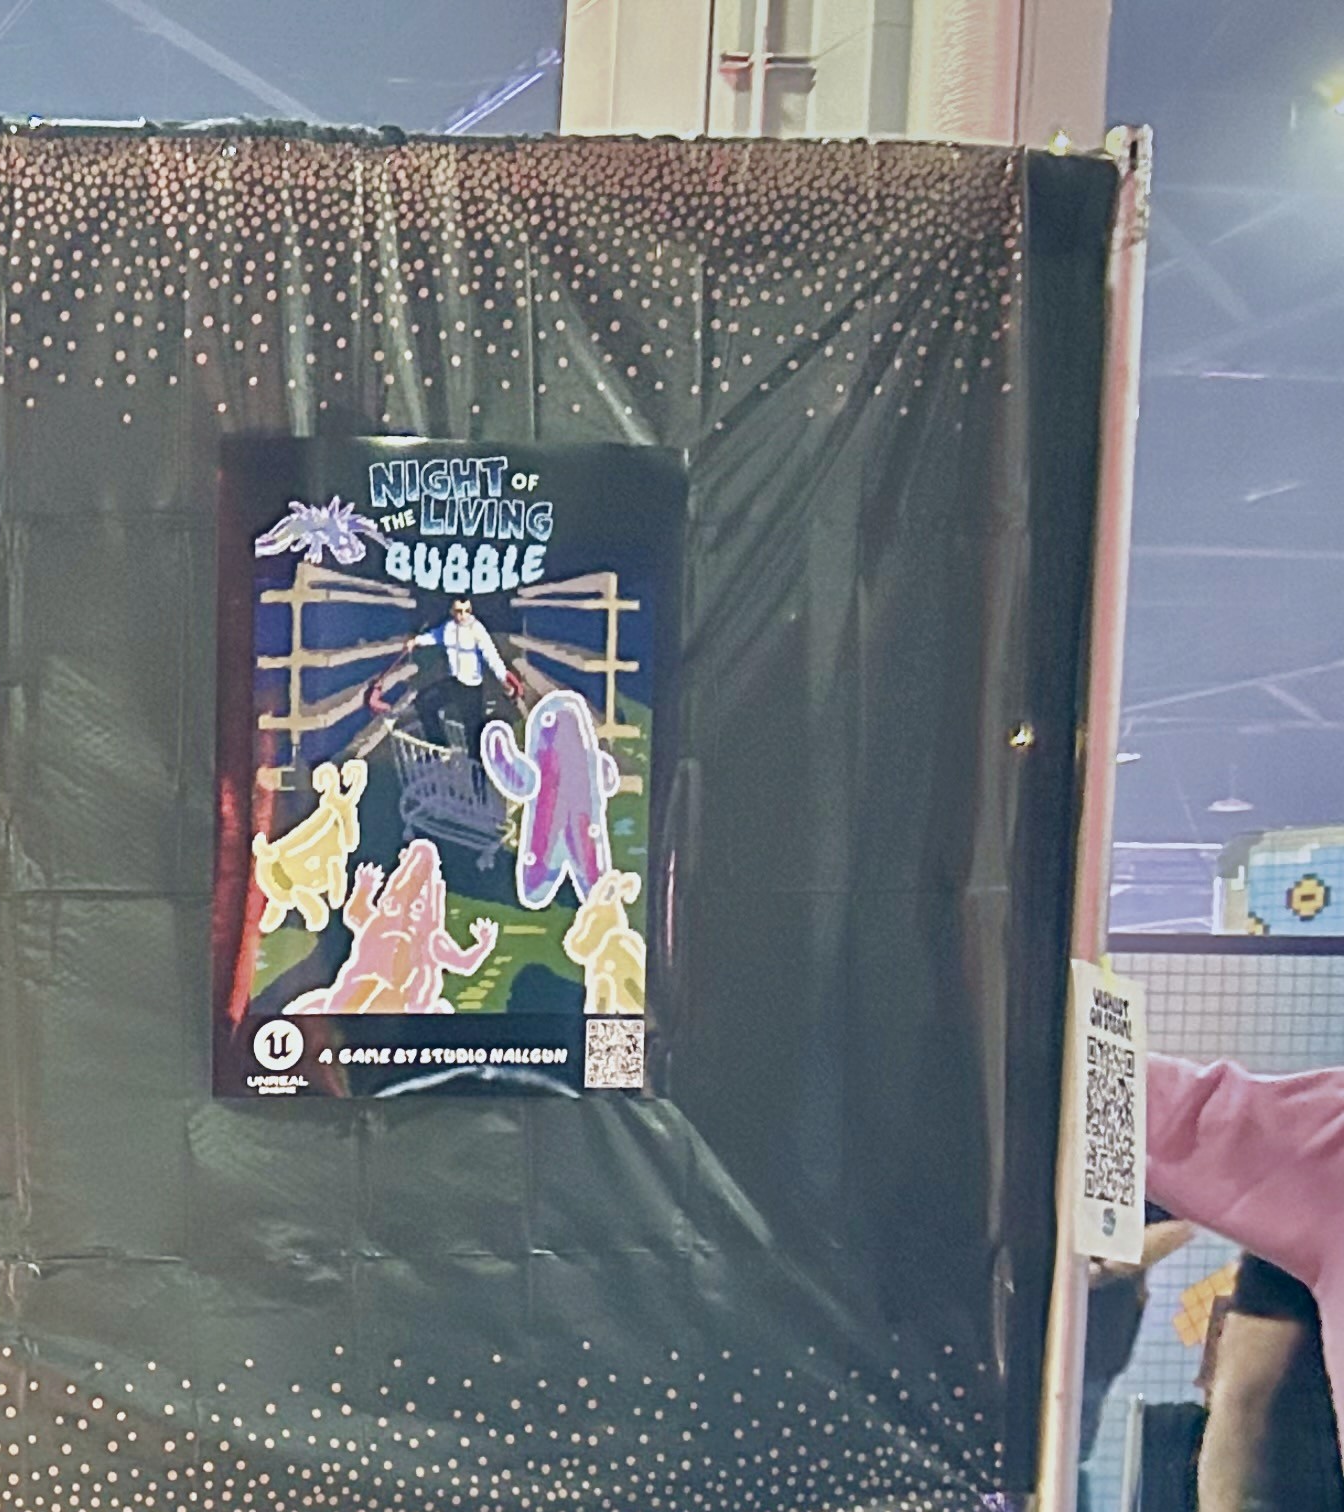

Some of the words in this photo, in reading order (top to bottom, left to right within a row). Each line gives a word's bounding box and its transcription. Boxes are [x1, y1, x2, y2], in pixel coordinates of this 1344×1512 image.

[370, 457, 507, 507] NIGHT
[511, 473, 539, 491] OF
[380, 509, 416, 532] THE
[419, 496, 553, 540] LIVING
[385, 542, 546, 593] BUBBLE
[318, 1048, 333, 1065] A
[338, 1048, 391, 1064] GAME
[393, 1048, 417, 1064] BY
[419, 1048, 487, 1064] STUDIO
[489, 1048, 568, 1064] NAILGUN
[246, 1075, 309, 1087] UNREAL
